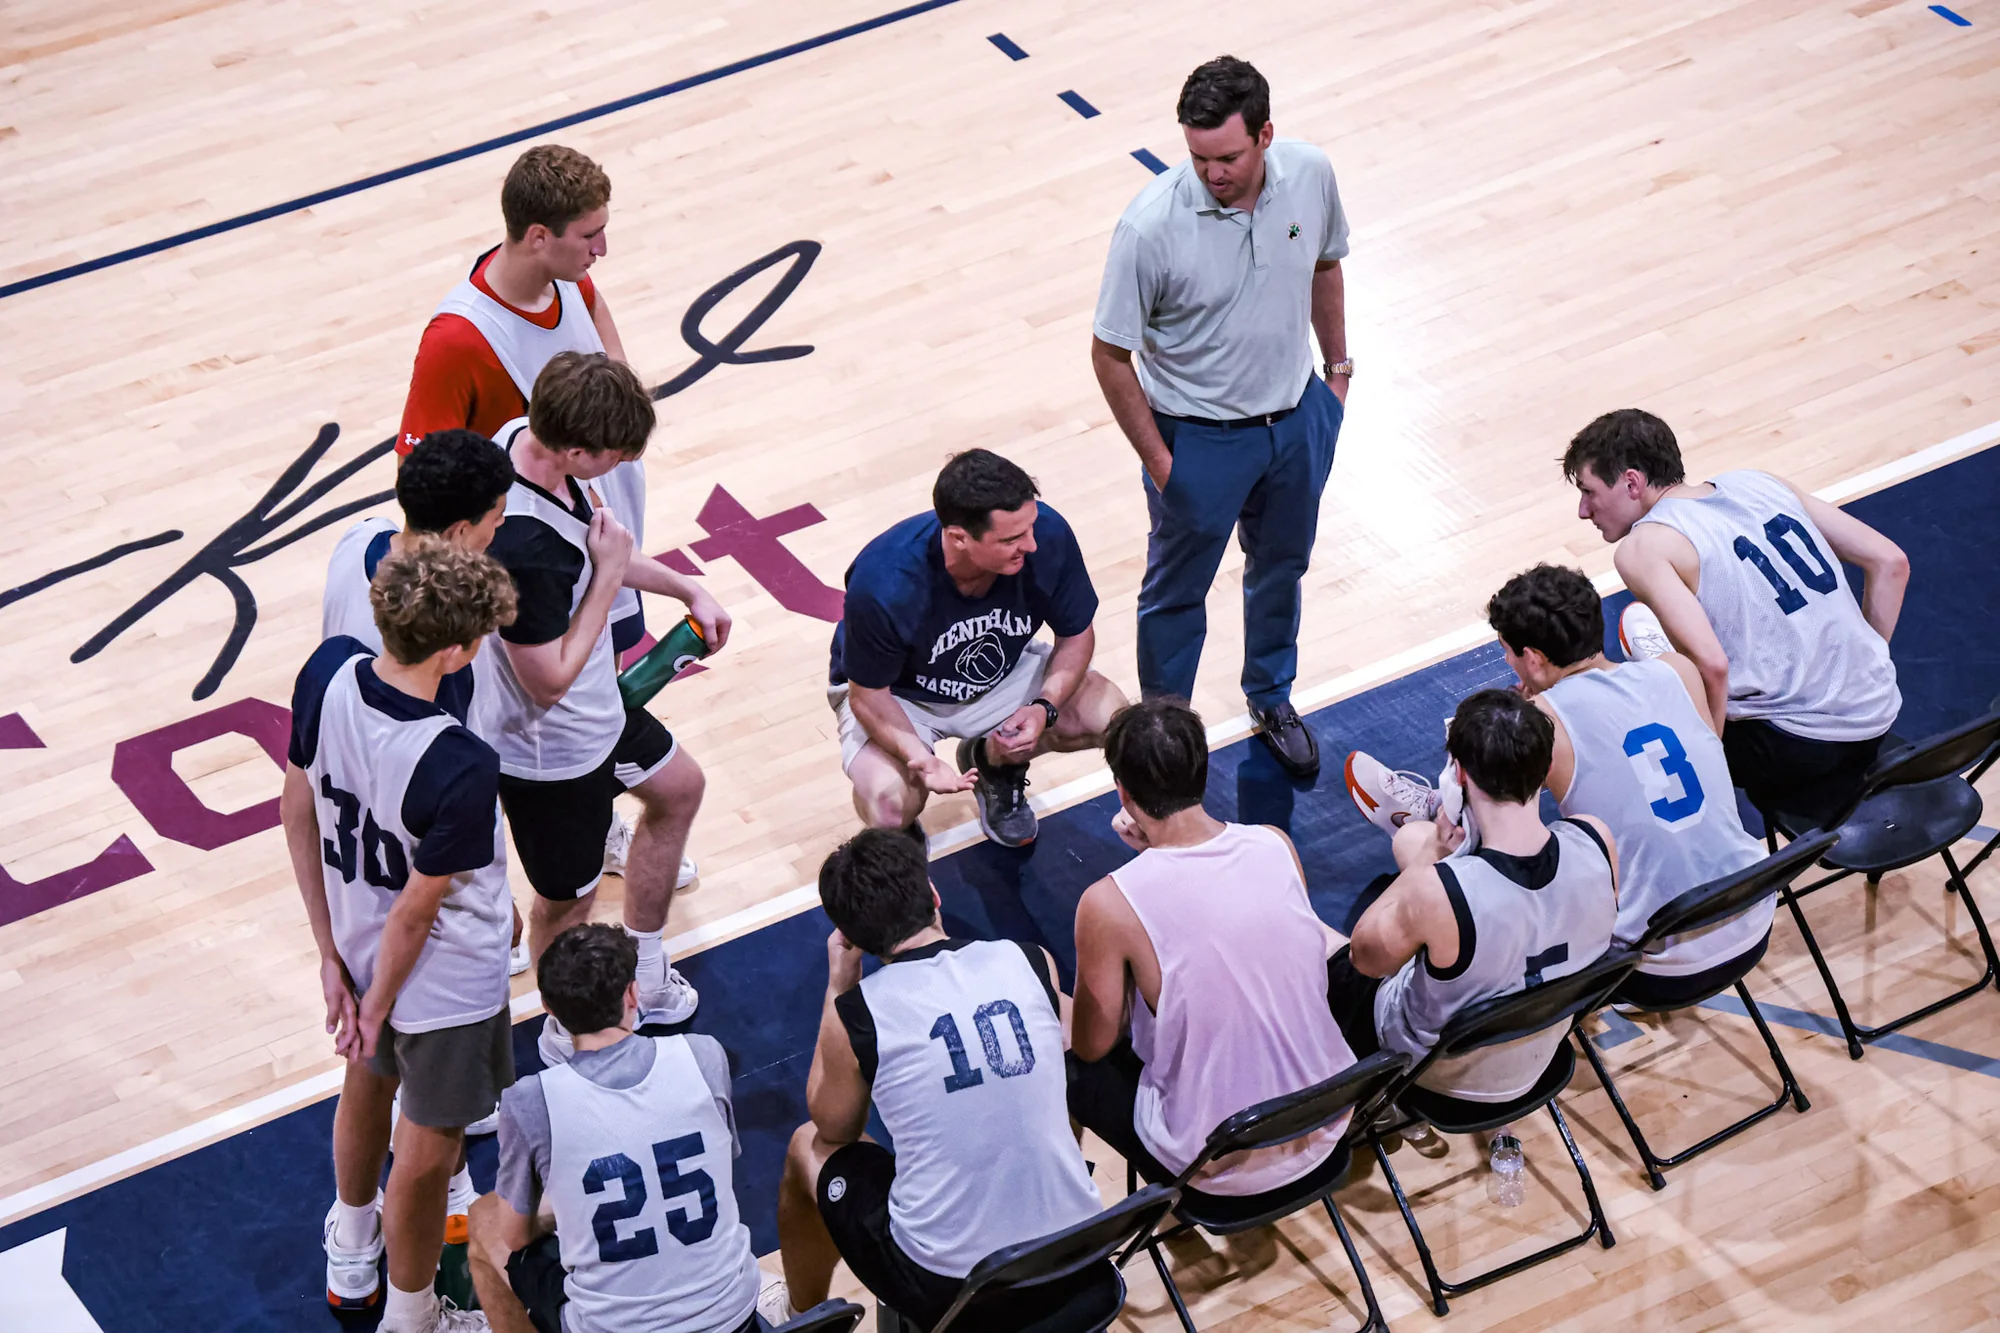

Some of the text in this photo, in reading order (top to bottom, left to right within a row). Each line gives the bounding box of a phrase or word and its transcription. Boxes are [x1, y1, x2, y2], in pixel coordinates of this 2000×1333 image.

[1732, 512, 1839, 616] 10
[927, 607, 1032, 665] MENDHAM
[1622, 721, 1706, 825] 3
[928, 998, 1036, 1094] 10
[582, 1130, 719, 1263] 25
